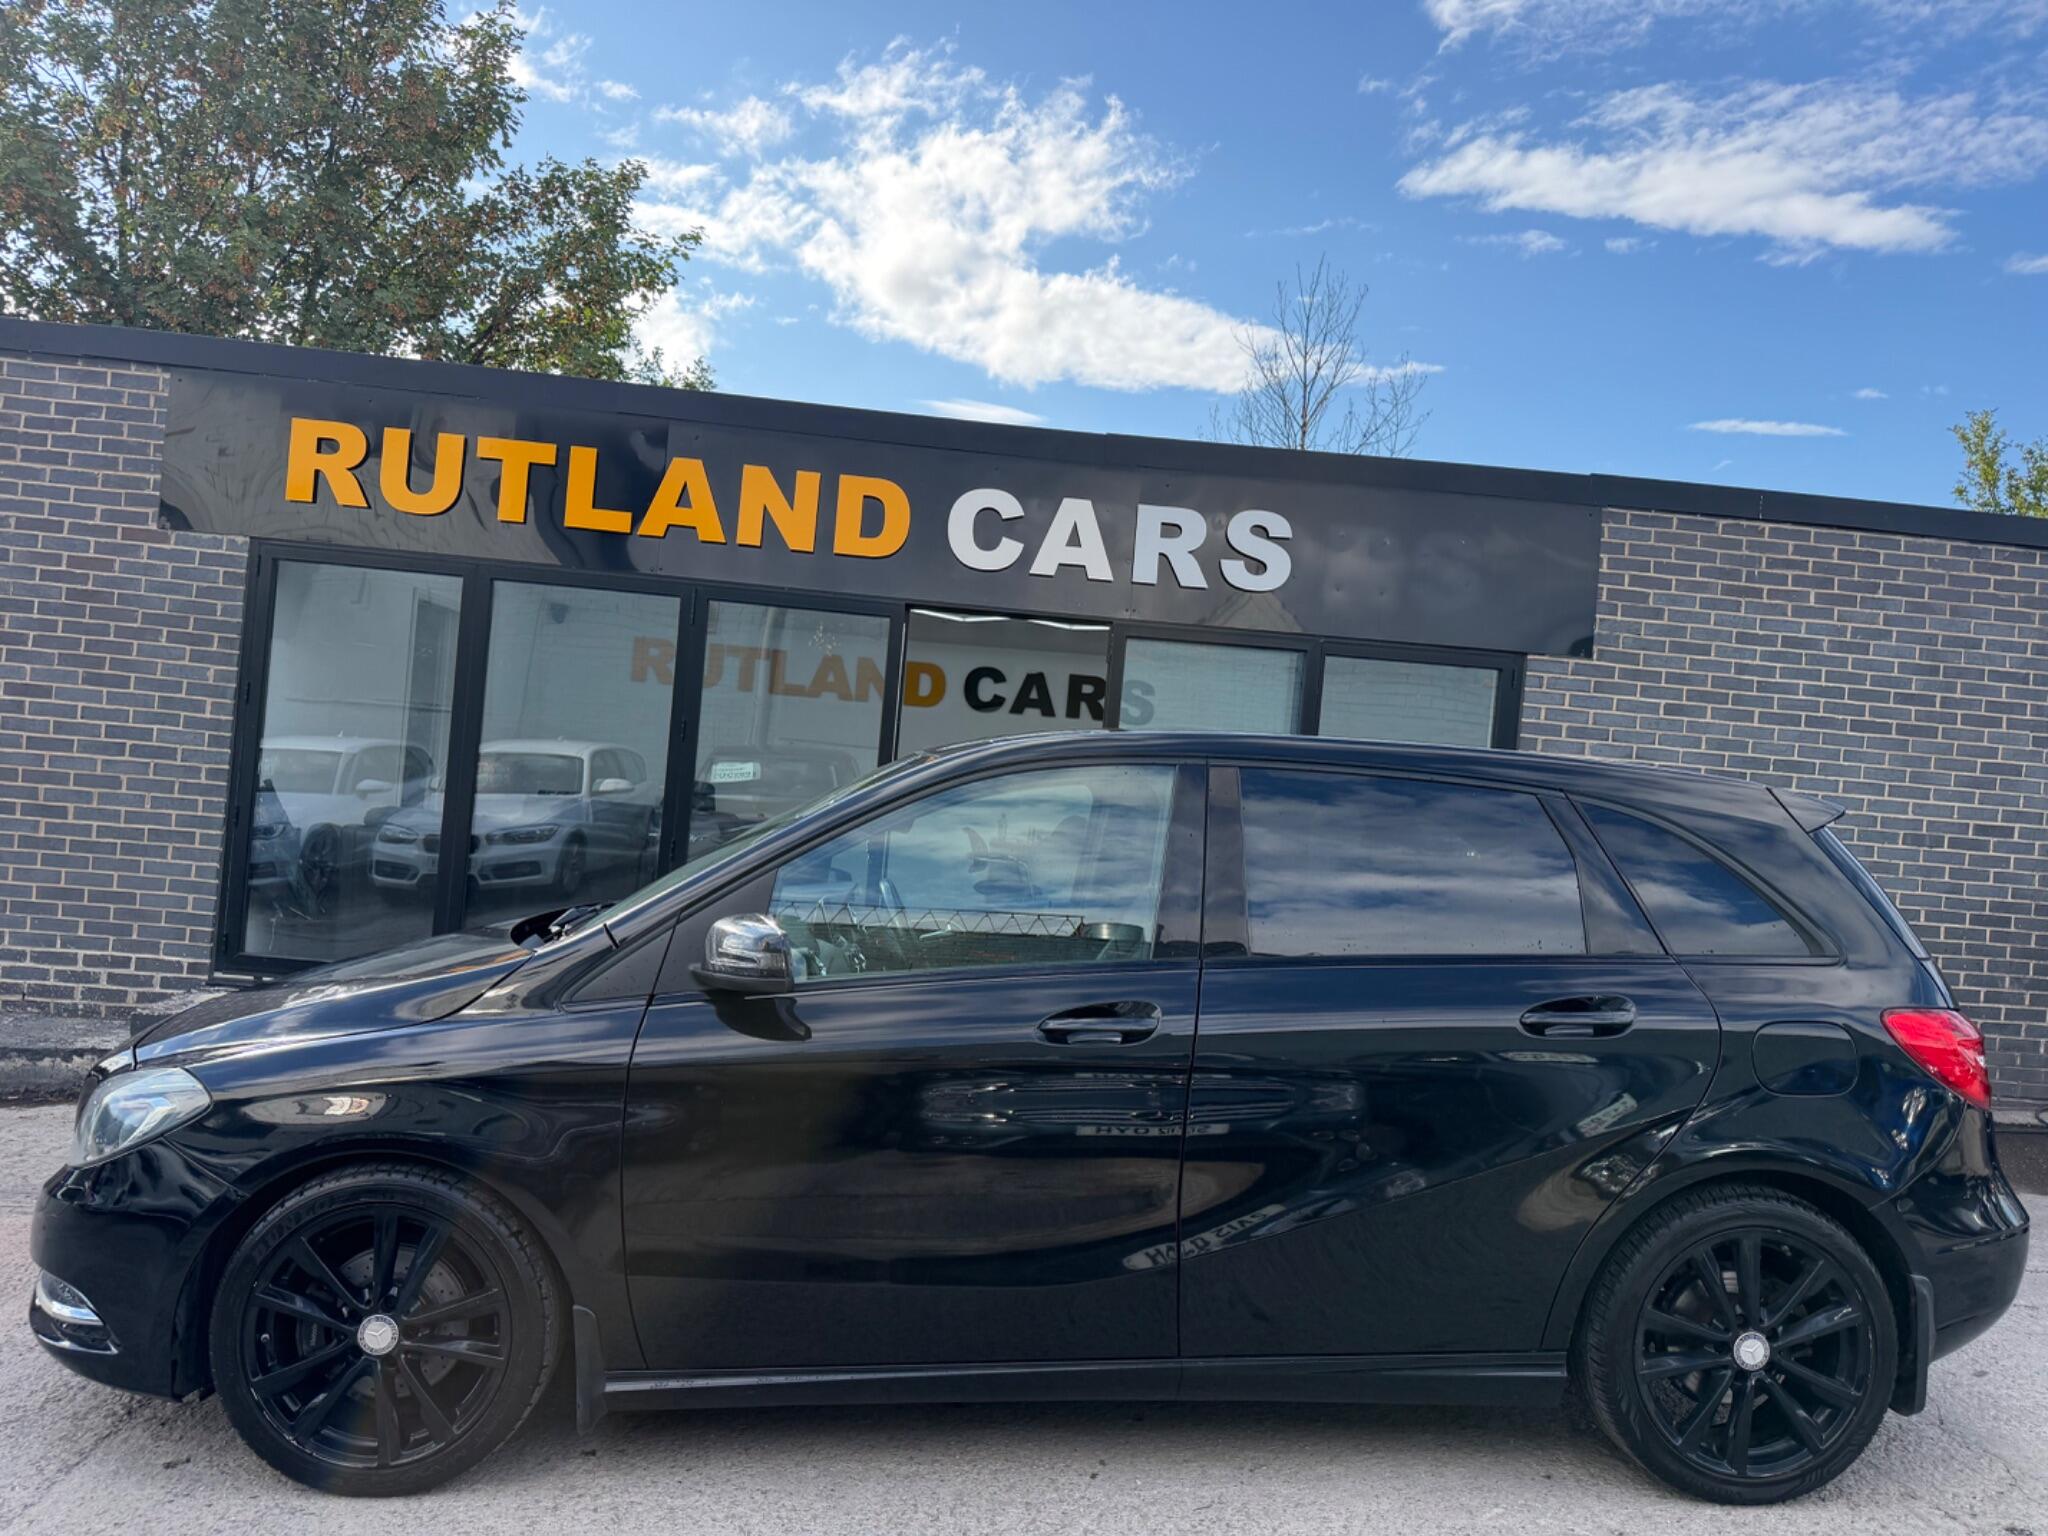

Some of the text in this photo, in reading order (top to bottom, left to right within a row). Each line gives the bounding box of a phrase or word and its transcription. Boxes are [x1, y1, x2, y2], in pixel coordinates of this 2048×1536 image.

[285, 417, 1293, 592] RUTLAND CARS
[964, 666, 1156, 726] CARS
